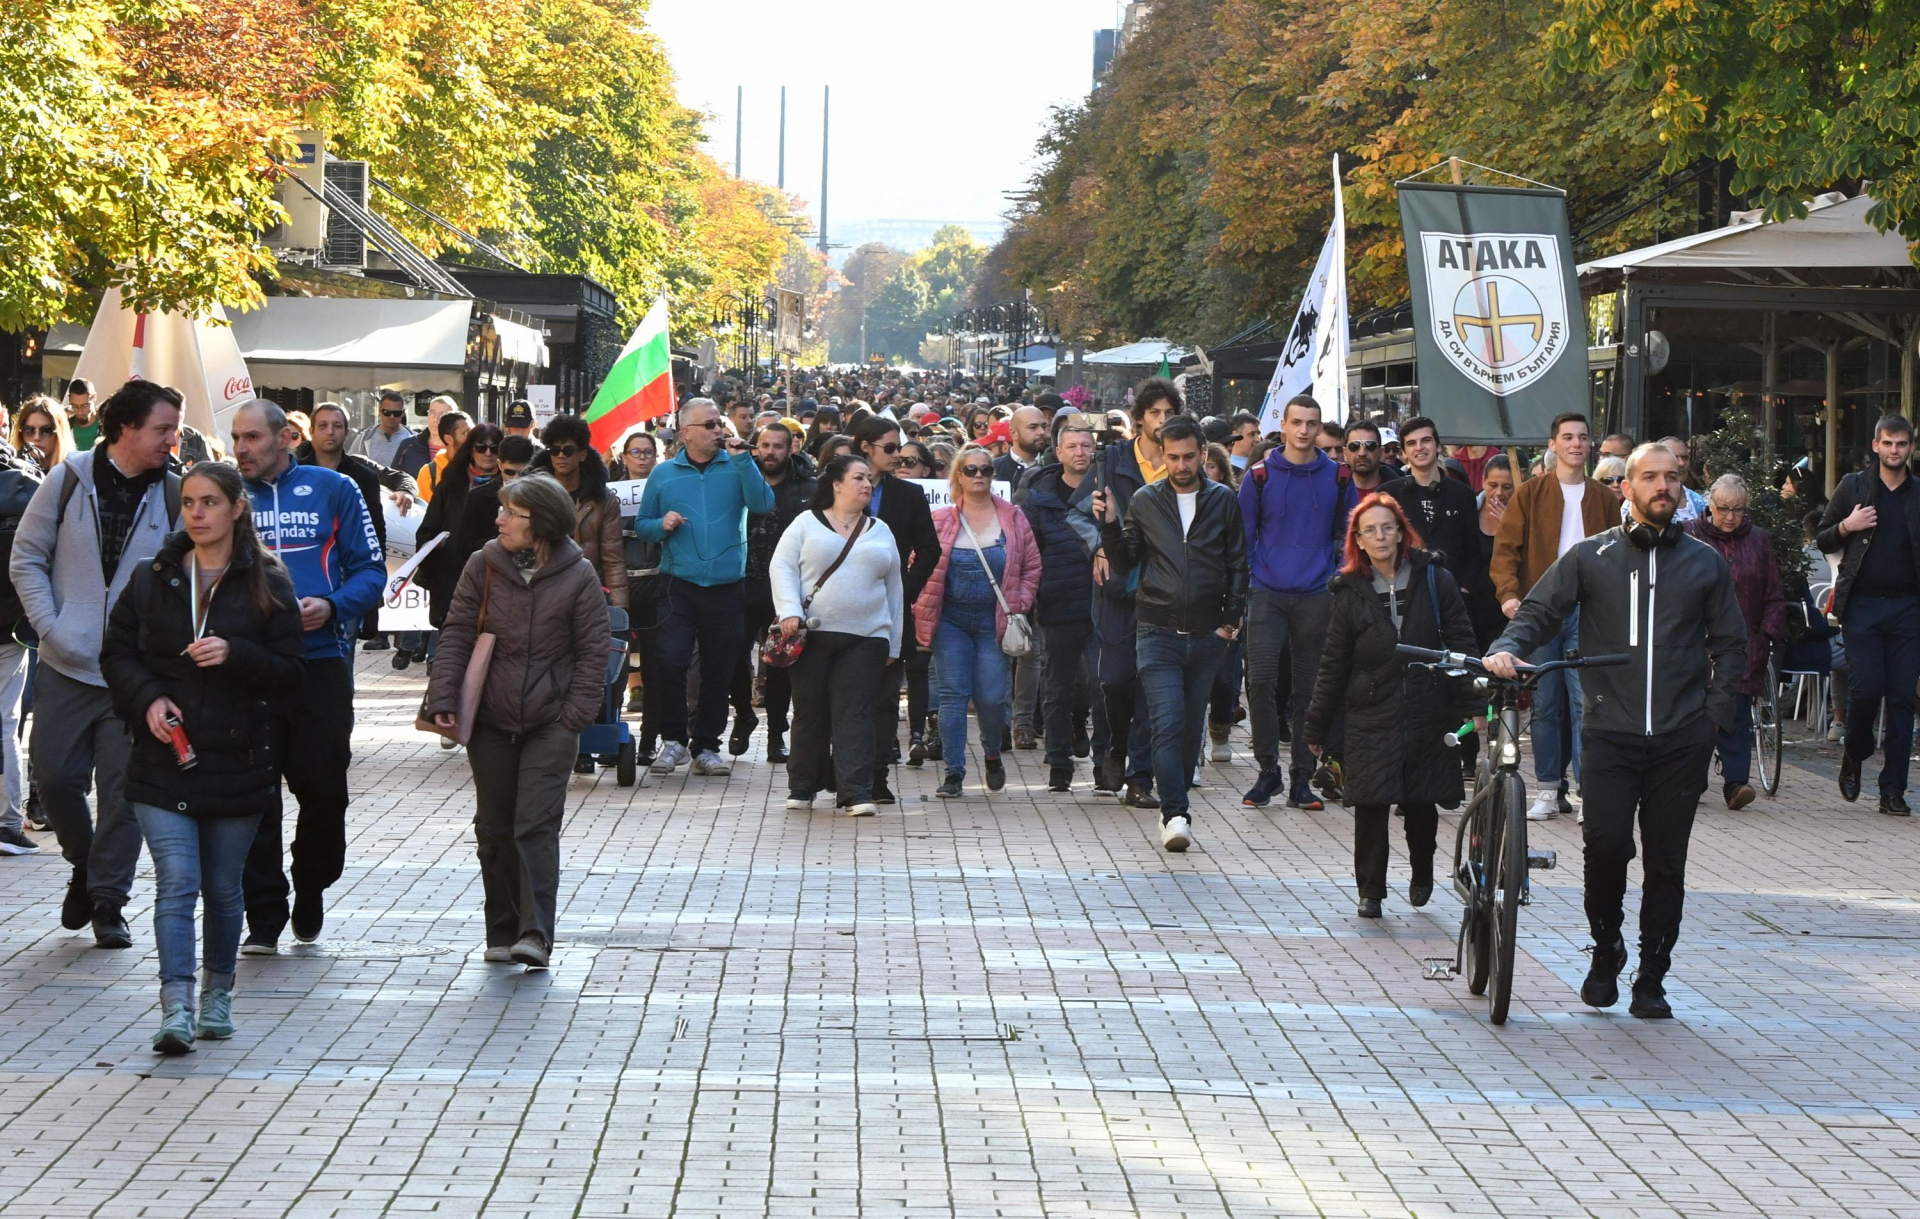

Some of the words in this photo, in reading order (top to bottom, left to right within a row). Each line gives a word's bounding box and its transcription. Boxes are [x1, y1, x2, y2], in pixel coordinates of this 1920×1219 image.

[1438, 239, 1546, 271] АТАКА
[1439, 320, 1453, 339] ДА
[1449, 341, 1465, 359] СИ
[1463, 358, 1515, 384] ВЪРНЕМ
[1517, 321, 1561, 379] БЪЛГАРИЯ
[224, 377, 252, 400] Coca
[254, 526, 317, 541] eranda's
